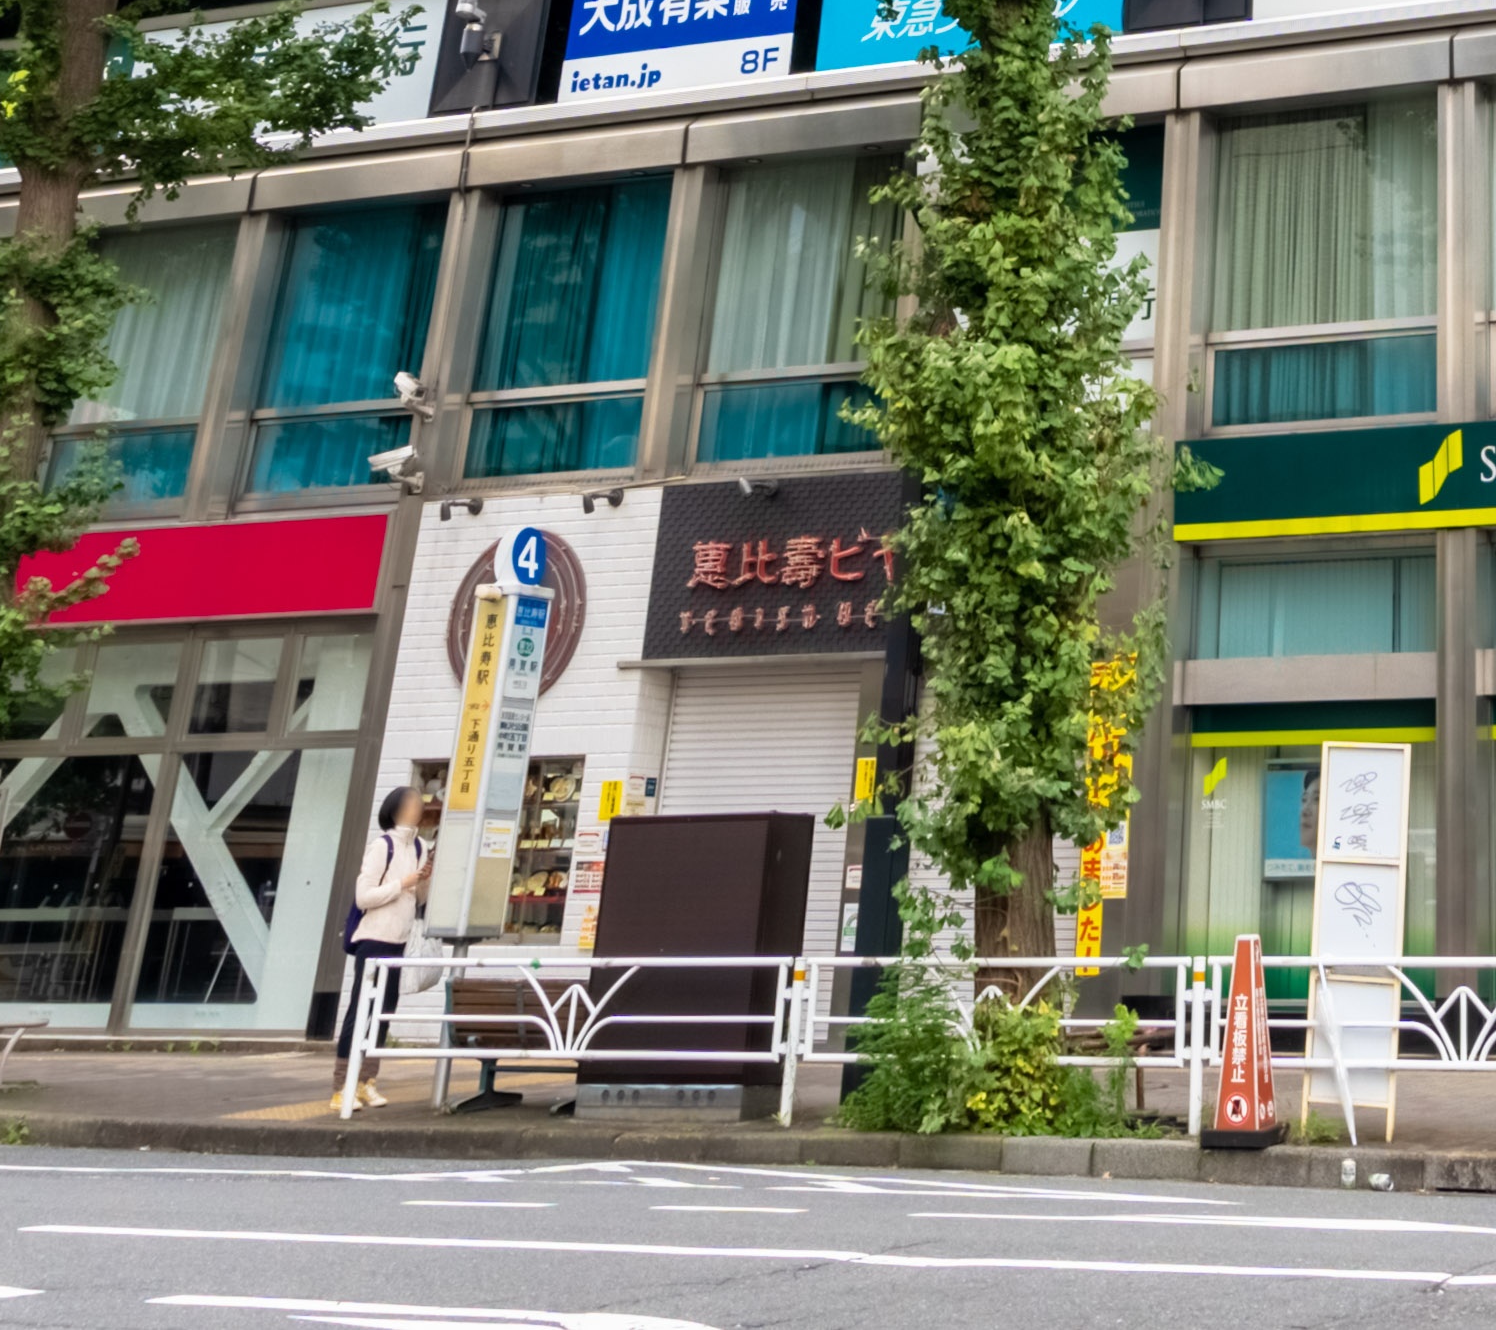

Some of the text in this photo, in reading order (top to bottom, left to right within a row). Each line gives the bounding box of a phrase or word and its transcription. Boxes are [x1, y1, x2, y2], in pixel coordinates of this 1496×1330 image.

[570, 46, 779, 93] ietan.jp 8F
[517, 536, 539, 579] 4
[516, 605, 546, 621] 恵比寿駅
[476, 613, 499, 686] 恵比寿駅
[460, 717, 482, 794] 下通り五丁目
[1201, 799, 1227, 810] SMBC
[1230, 993, 1249, 1084] 立看板禁止
